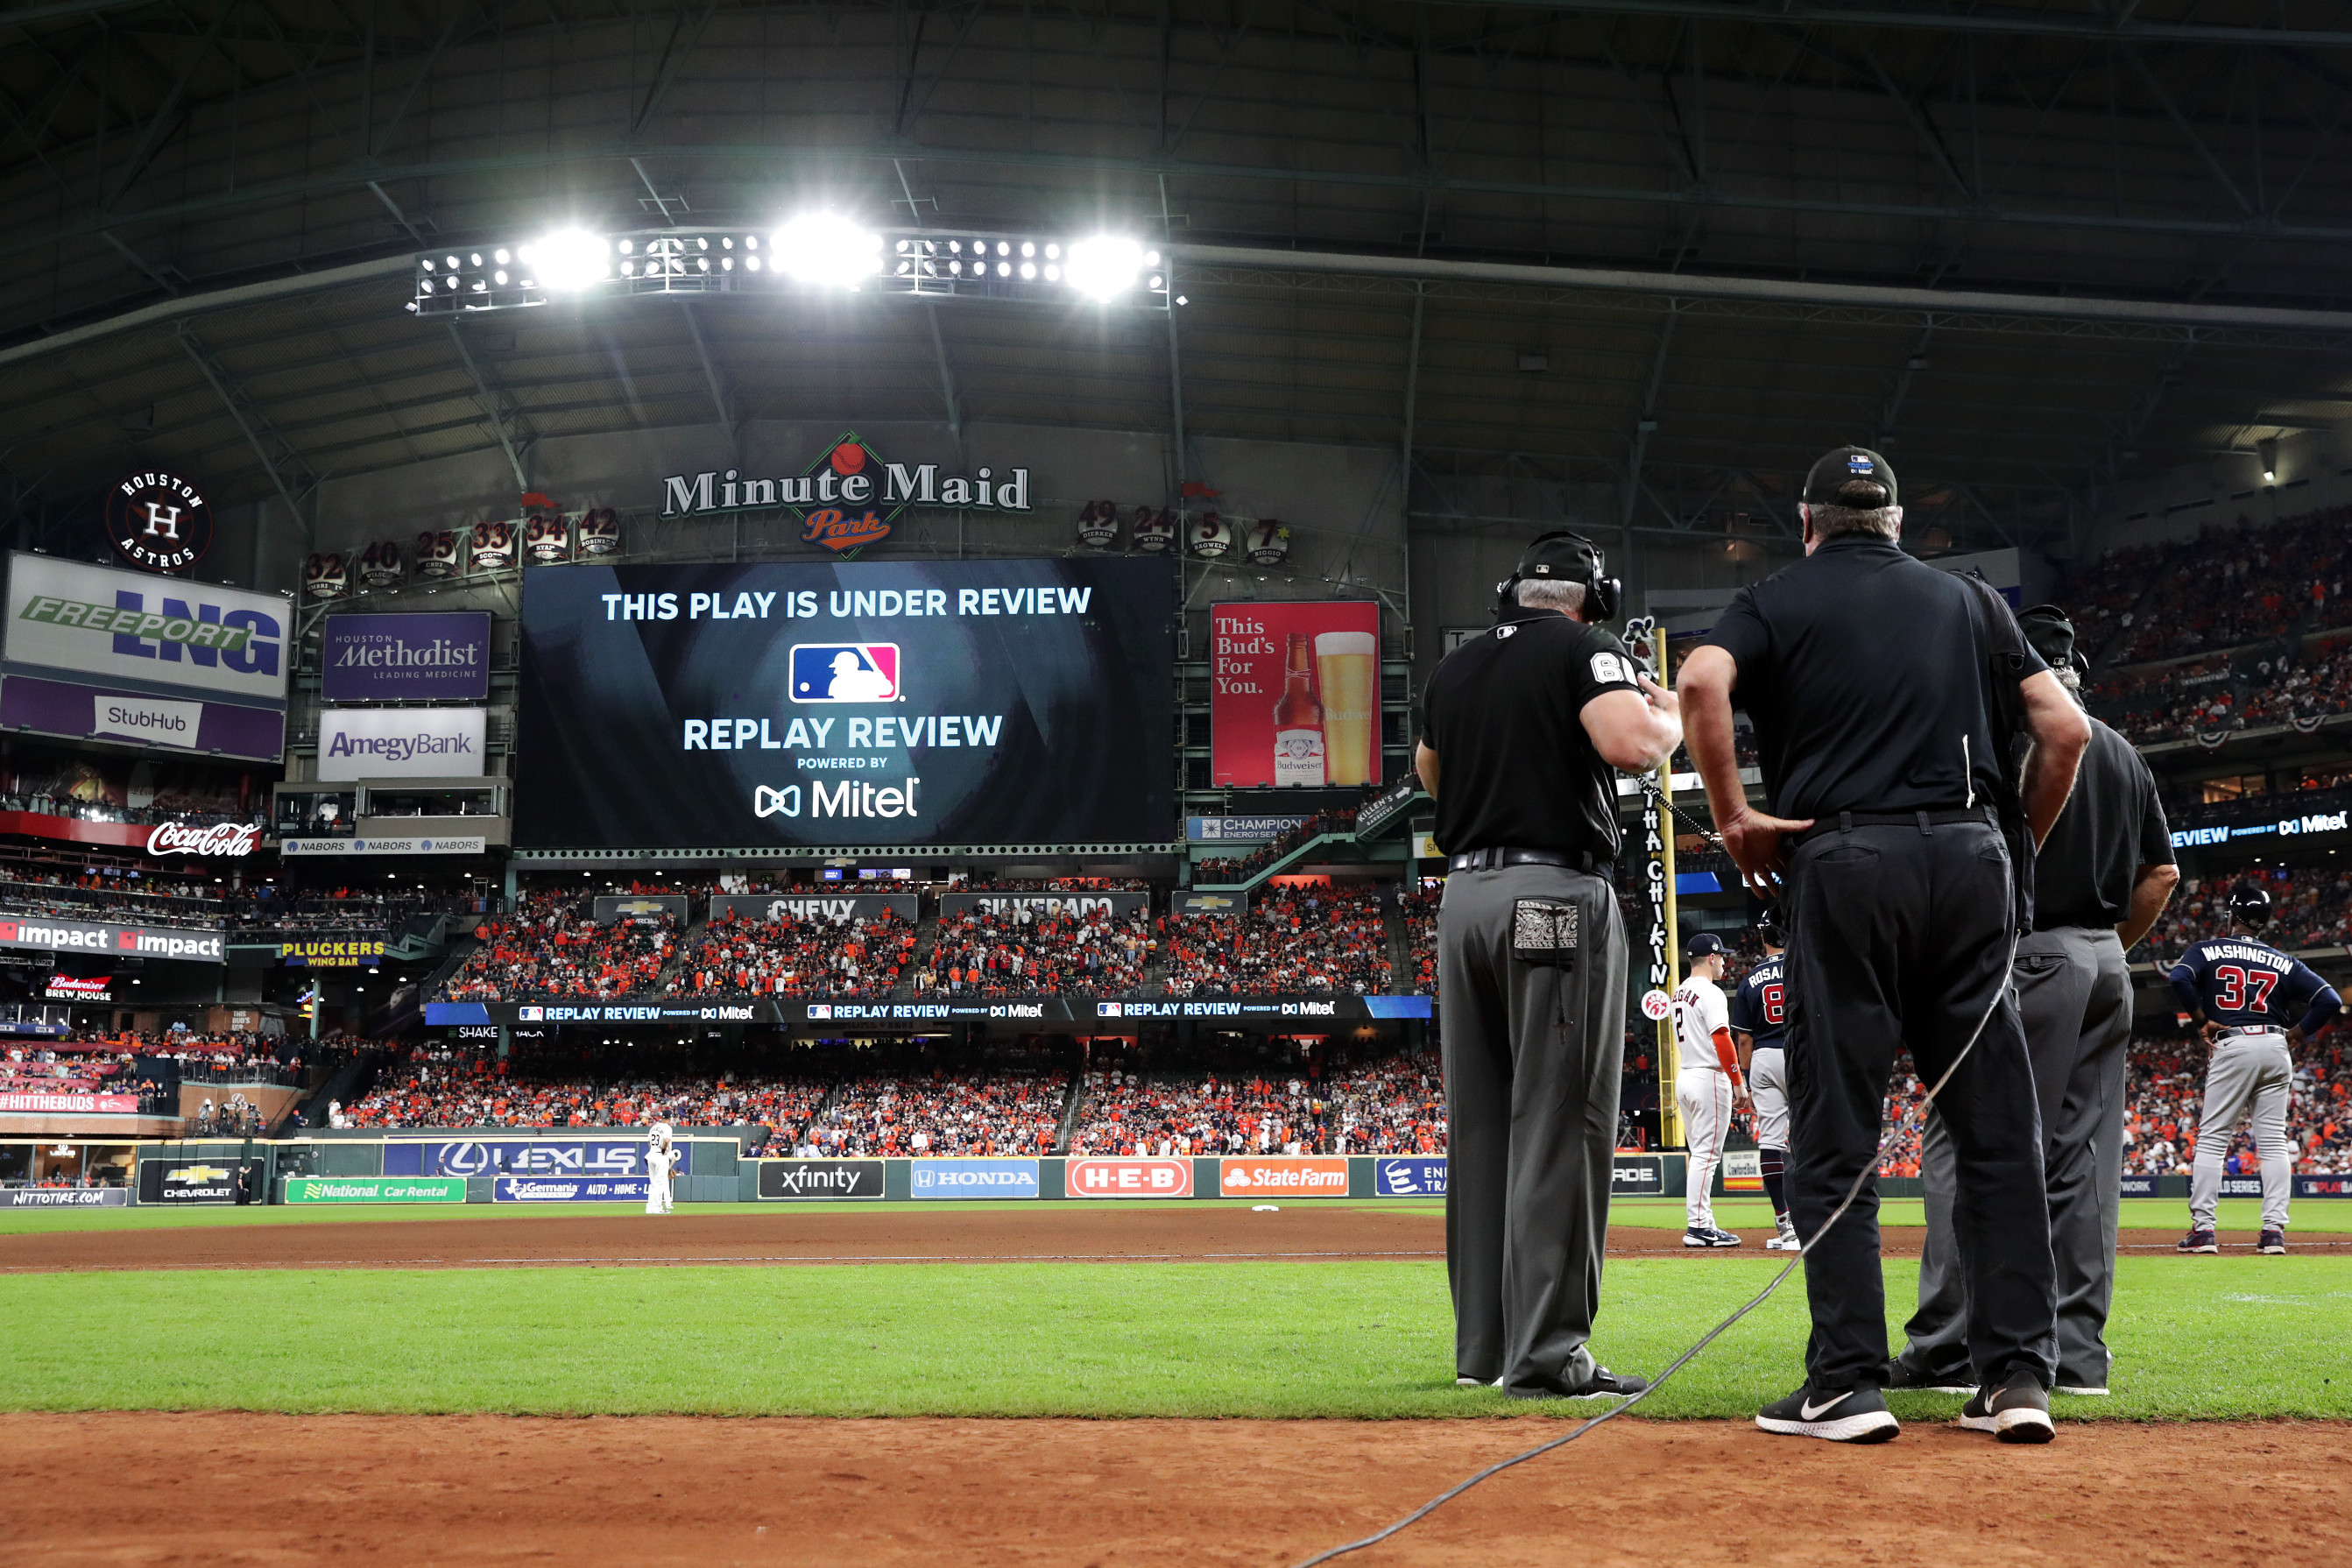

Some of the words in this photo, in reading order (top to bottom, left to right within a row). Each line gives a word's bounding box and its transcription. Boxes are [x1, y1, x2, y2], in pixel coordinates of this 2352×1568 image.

[122, 473, 202, 507] HOUSTON
[662, 469, 873, 517] Minute
[883, 462, 1032, 511] Maid
[143, 501, 181, 540] H
[580, 508, 617, 535] 42
[1078, 500, 1117, 527] 49
[1134, 505, 1176, 533] 24
[471, 522, 508, 549] 33
[526, 513, 565, 541] 34
[804, 511, 889, 550] Park
[1200, 512, 1219, 540] 5
[1257, 519, 1277, 547] 7
[121, 538, 194, 567] ASTROS
[362, 541, 398, 569] 40
[417, 531, 454, 558] 25
[1194, 542, 1227, 551] BAGWELL
[307, 553, 343, 579] 32
[602, 594, 678, 620] THIS
[689, 592, 775, 619] PLAY
[787, 591, 816, 618] IS
[830, 590, 947, 618] UNDER
[959, 587, 1091, 615] REVIEW
[29, 597, 249, 648] FREEPORT
[113, 590, 280, 676] LNG
[1216, 617, 1265, 634] This
[334, 639, 478, 667] Methodist
[1217, 637, 1275, 654] Bud’s
[1217, 658, 1253, 674] For
[1216, 677, 1263, 694] You.
[108, 707, 187, 731] StubHub
[684, 718, 836, 750] REPLAY
[849, 715, 1002, 748] REVIEW
[328, 731, 471, 759] AmegyBank
[797, 758, 865, 769] POWERED
[870, 757, 887, 768] BY
[1277, 760, 1322, 770] Budweiser
[812, 777, 921, 817] Mitel
[1358, 795, 1394, 823] KILLEN'S
[1224, 819, 1302, 830] CHAMPION
[2172, 826, 2229, 848] EVIEW
[2231, 825, 2265, 837] POWERED
[2301, 810, 2348, 833] Mitel
[147, 822, 260, 856] Coca-Cola
[300, 843, 345, 851] NABORS
[368, 842, 412, 851] NABORS
[434, 841, 479, 850] NABORS
[772, 900, 856, 921] CHEVY
[18, 921, 109, 948] impact
[137, 929, 220, 957] impact
[282, 942, 385, 956] PLUCKERS
[2201, 944, 2293, 975] WASHINGTON
[307, 957, 335, 966] WING
[338, 957, 358, 966] BAR
[50, 976, 105, 990] Budweiser
[1748, 966, 1783, 988] ROSA
[46, 988, 74, 999] BREW
[77, 990, 111, 1001] HOUSE
[2215, 965, 2278, 1014] 37
[546, 1007, 601, 1020] REPLAY
[604, 1006, 660, 1020] REVIEW
[719, 1006, 754, 1020] Mitel
[834, 1006, 889, 1018] REPLAY
[893, 1005, 950, 1018] REVIEW
[1008, 1004, 1043, 1018] Mitel
[1124, 1003, 1180, 1016] REPLAY
[1184, 1002, 1241, 1015] REVIEW
[1300, 1000, 1335, 1015] Mitel
[1762, 983, 1783, 1024] 8
[459, 1027, 498, 1038] SHAKE
[1675, 1007, 1685, 1042] 2
[1731, 1063, 1738, 1073] 2
[0, 1095, 95, 1111] #HITTHEBUDS
[651, 1134, 660, 1146] 23
[493, 1148, 637, 1168] LEXUS
[526, 1183, 578, 1192] Germania
[586, 1184, 607, 1195] AUTO
[614, 1183, 638, 1195] HOME
[782, 1165, 861, 1194] xfinity
[937, 1172, 1036, 1185] HONDA
[1084, 1168, 1174, 1188] H-E-B
[2230, 1180, 2261, 1193] SERIES
[13, 1190, 103, 1205] NITTOTIRE.COM
[164, 1189, 231, 1198] CHEVROLET
[321, 1184, 378, 1197] National
[385, 1186, 405, 1197] Car
[406, 1186, 449, 1197] Rental
